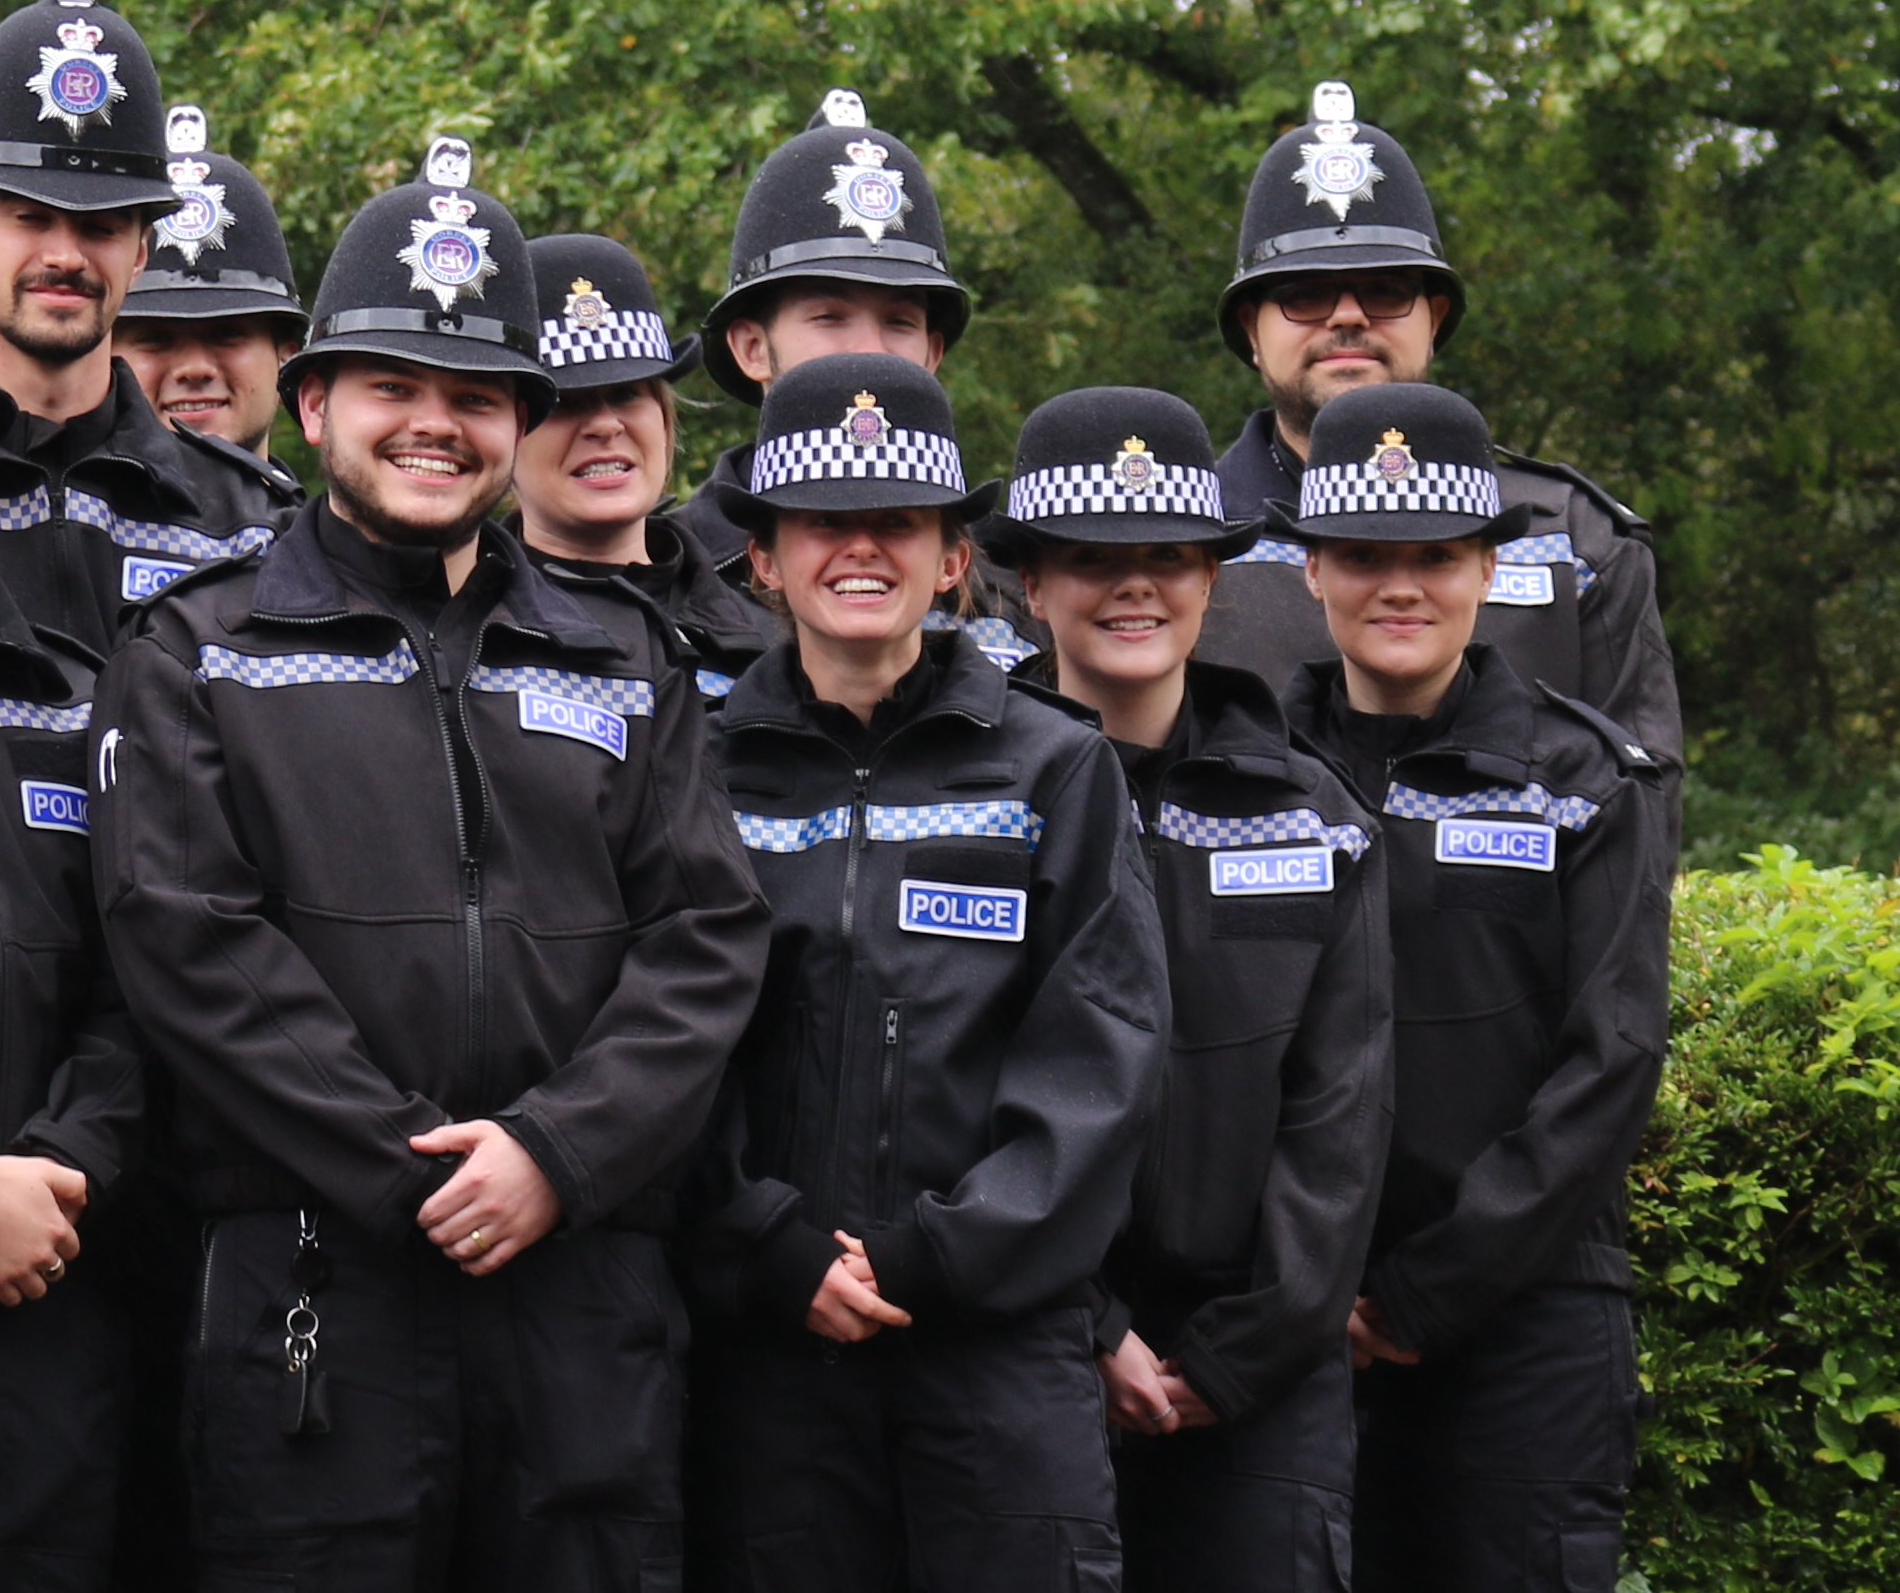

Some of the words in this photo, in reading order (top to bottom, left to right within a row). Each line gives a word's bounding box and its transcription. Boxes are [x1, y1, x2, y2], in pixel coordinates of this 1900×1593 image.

[1490, 573, 1542, 595] ICE
[532, 699, 620, 746] POLICE
[34, 792, 90, 825] POLI
[1449, 829, 1544, 859] POLICE
[1222, 858, 1320, 885] POLICE
[911, 893, 1012, 928] POLICE
